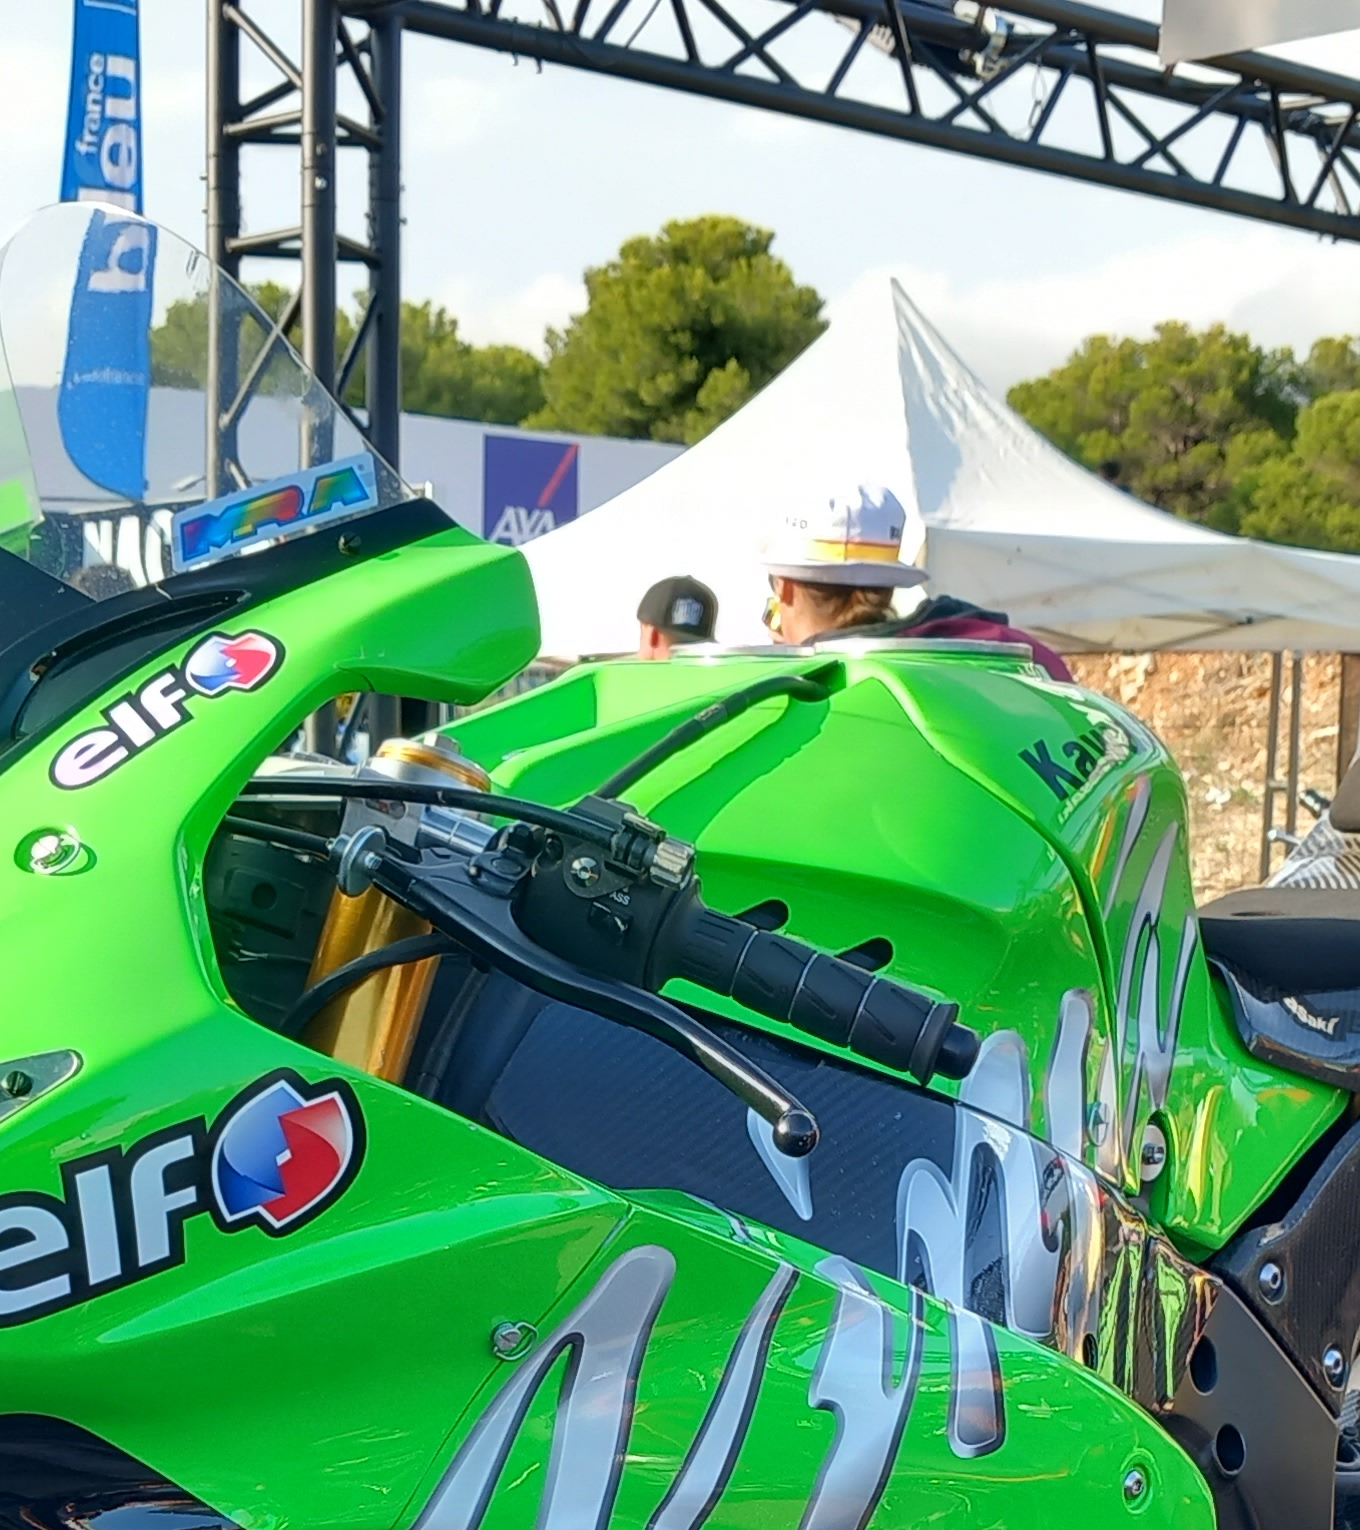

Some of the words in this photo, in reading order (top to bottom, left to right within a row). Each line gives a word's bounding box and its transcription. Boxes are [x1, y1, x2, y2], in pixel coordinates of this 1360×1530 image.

[75, 51, 105, 155] france
[77, 54, 150, 293] bleu
[182, 466, 371, 562] MRA
[53, 672, 187, 787] elf
